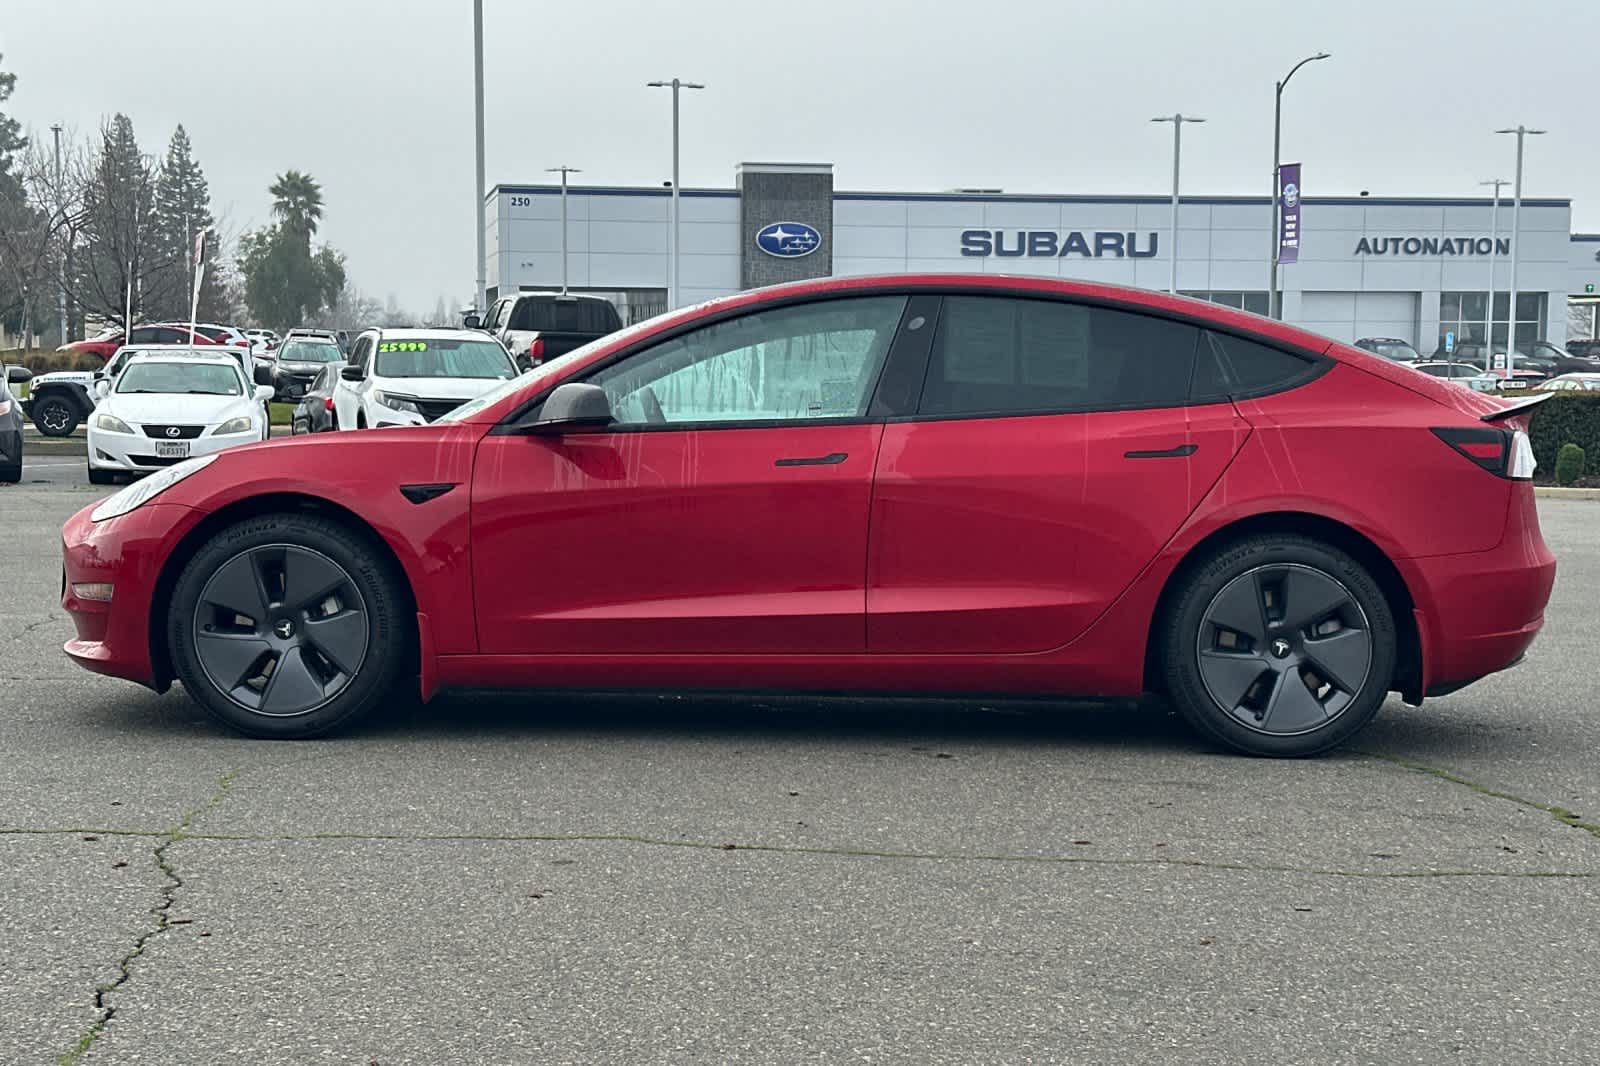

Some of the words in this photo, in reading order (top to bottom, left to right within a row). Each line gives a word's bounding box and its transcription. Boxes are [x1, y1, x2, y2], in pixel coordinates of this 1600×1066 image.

[511, 197, 530, 207] 250
[960, 230, 1159, 258] SUBARU
[1354, 237, 1511, 256] AUTONATION
[380, 342, 427, 352] 25999
